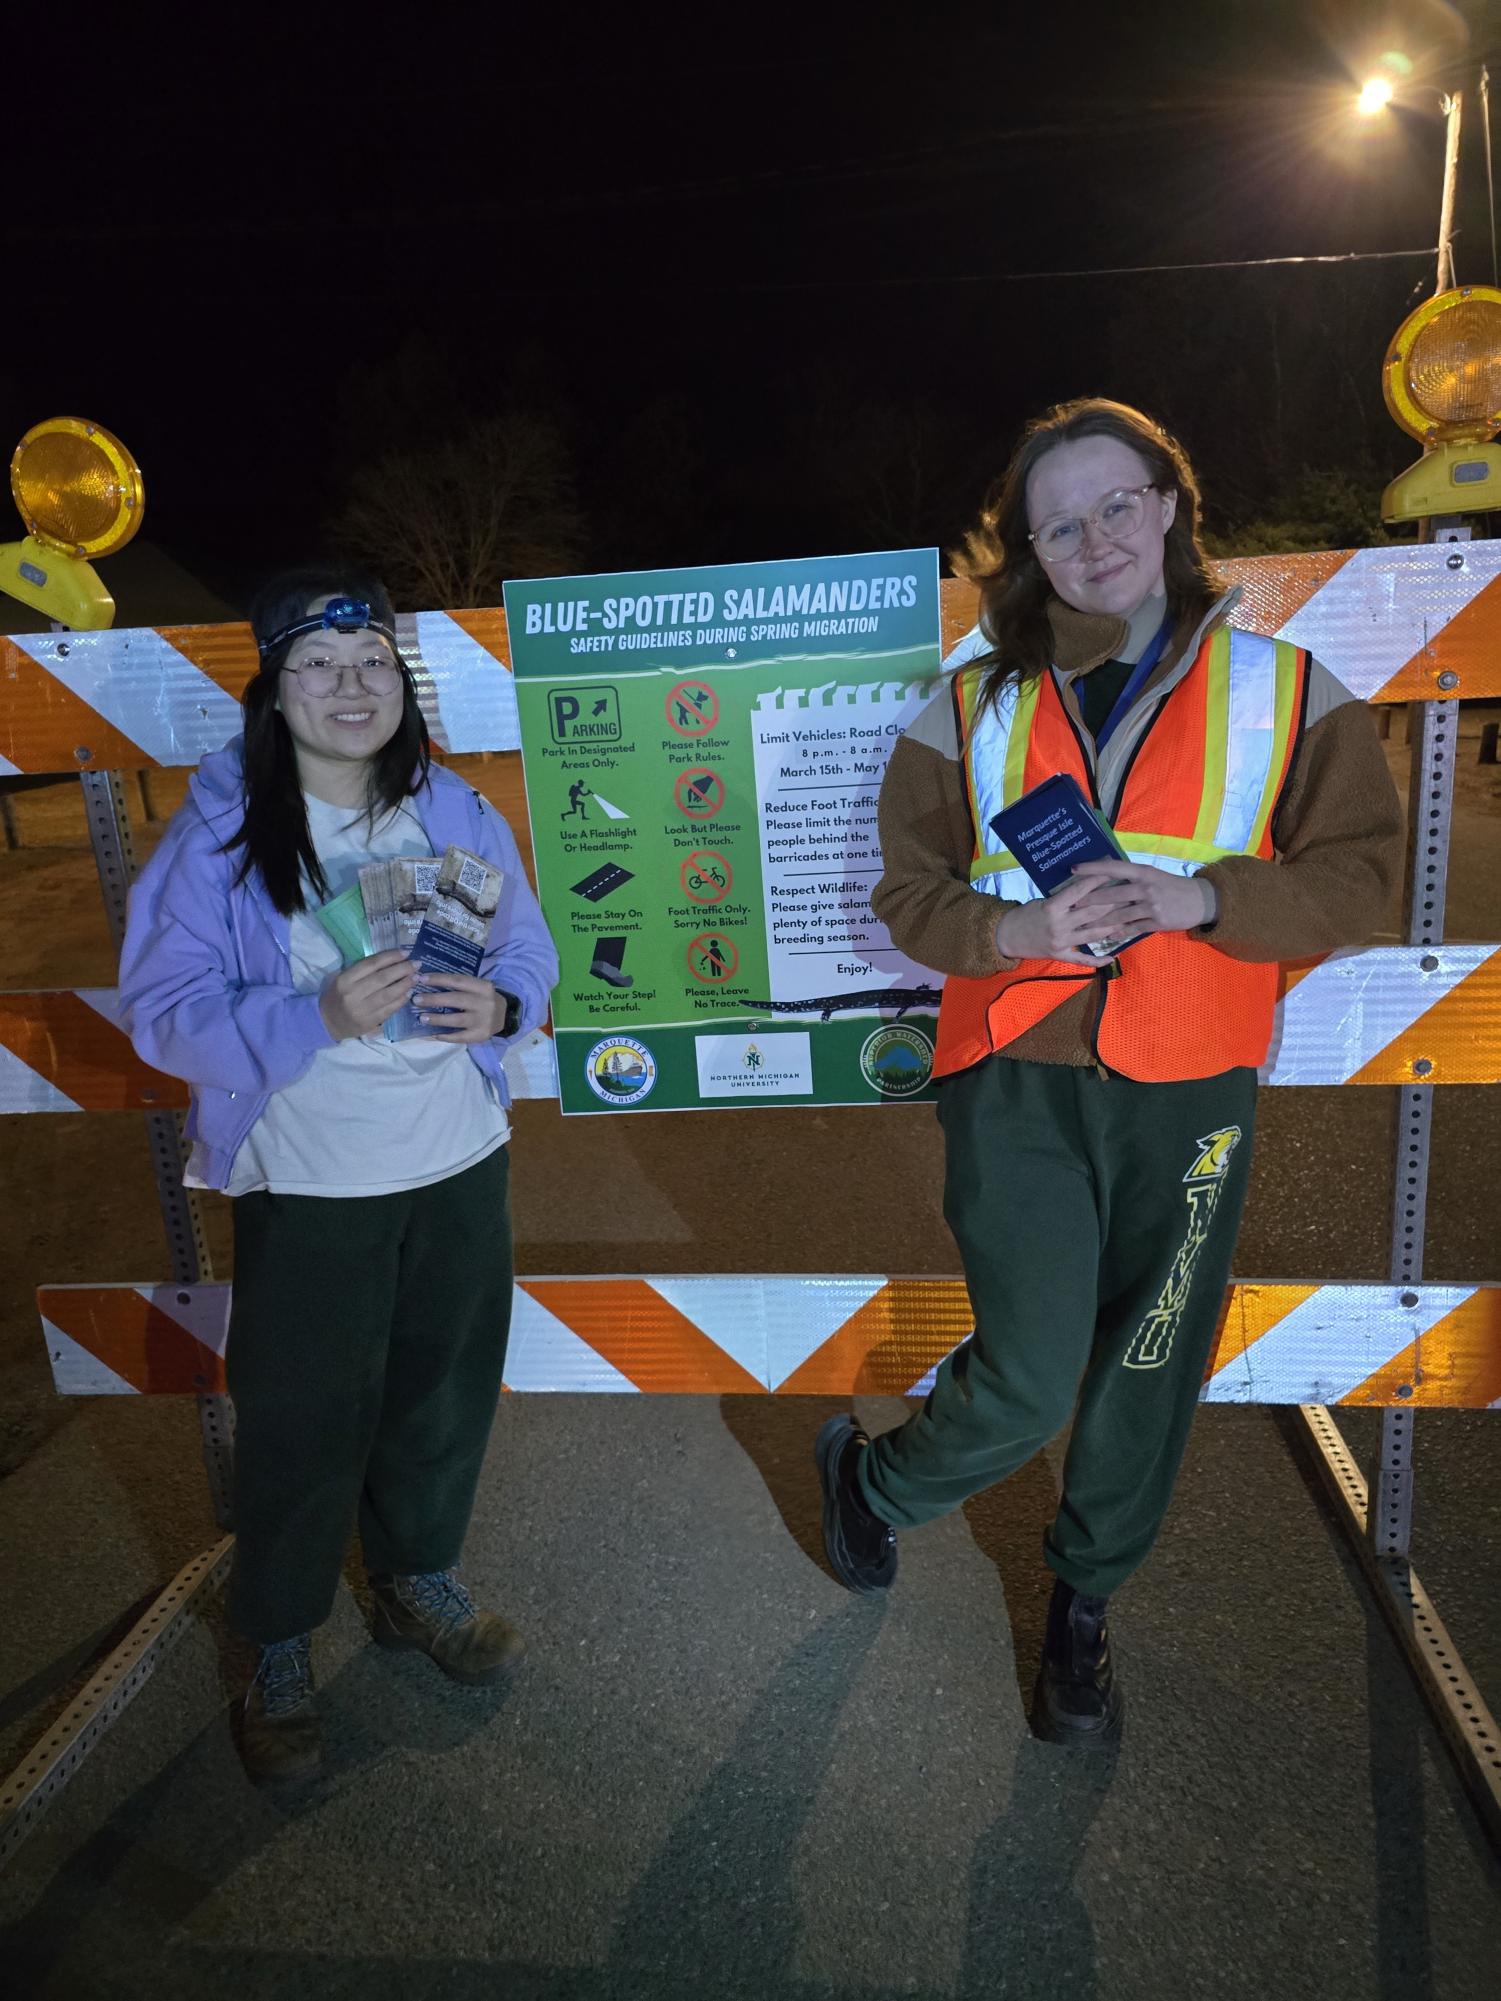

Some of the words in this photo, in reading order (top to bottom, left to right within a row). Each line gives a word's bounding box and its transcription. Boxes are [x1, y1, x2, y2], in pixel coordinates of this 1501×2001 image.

[525, 591, 715, 634] BLUE-SPOTTED
[722, 575, 917, 621] SALAMANDERS
[570, 635, 615, 654] SAFETY
[618, 630, 692, 650] GUIDELINES
[696, 626, 747, 645] DURING
[750, 622, 799, 641] SPRING
[803, 616, 879, 637] MIGRATION
[760, 733, 790, 744] Limit
[792, 729, 846, 742] Vehicles:
[849, 725, 882, 739] Road
[885, 724, 907, 736] Clo
[541, 747, 566, 757] Park
[567, 747, 578, 755] In
[579, 741, 635, 756] Designated
[662, 741, 694, 750] Please
[696, 737, 730, 748] Follow
[668, 752, 693, 763] Park
[695, 752, 725, 762] Rules.
[802, 749, 808, 758] 8
[850, 746, 856, 754] 8
[560, 760, 590, 770] Areas
[592, 757, 619, 769] Only.
[780, 765, 816, 778] March
[820, 764, 843, 775] 15th
[854, 762, 880, 775] May
[765, 801, 808, 813] Reduce
[810, 799, 838, 811] Foot
[664, 824, 689, 835] Look
[690, 824, 708, 833] But
[709, 822, 742, 833] Please
[766, 819, 803, 830] Please
[805, 817, 831, 828] limit
[834, 816, 852, 826] the
[855, 816, 879, 825] num
[1017, 807, 1067, 843] Marquette's
[560, 831, 578, 840] Use
[580, 829, 588, 839] A
[590, 827, 637, 839] Flashlight
[767, 835, 806, 849] people
[808, 832, 848, 845] behind
[850, 832, 870, 842] the
[1025, 828, 1058, 852] Presque
[1058, 818, 1074, 831] Isle
[564, 843, 577, 853] Or
[579, 842, 633, 852] Headlamp.
[673, 837, 700, 847] Don't
[701, 835, 734, 846] Touch.
[1031, 824, 1083, 863] Blue-Spotted
[768, 850, 830, 863] barricades
[832, 850, 844, 860] at
[846, 849, 868, 859] one
[871, 847, 883, 858] ti
[1038, 835, 1091, 872] Salamanders
[770, 885, 816, 898] Respect
[818, 881, 868, 894] Wildlife:
[668, 907, 690, 916] Foot
[691, 905, 723, 915] Traffic
[724, 904, 751, 915] Only.
[771, 902, 808, 913] Please
[810, 901, 835, 913] give
[837, 898, 872, 909] salam
[571, 911, 602, 921] Please
[604, 910, 626, 920] Stay
[628, 909, 643, 918] On
[571, 924, 589, 933] The
[591, 922, 642, 932] Pavement.
[674, 919, 701, 929] Sorry
[703, 918, 717, 927] No
[719, 916, 748, 926] Bikes!
[773, 918, 808, 931] plenty
[811, 916, 823, 927] of
[825, 917, 857, 928] space
[859, 914, 882, 924] dur
[773, 933, 824, 945] breeding
[827, 933, 870, 942] season.
[837, 961, 873, 976] Enjoy!
[573, 992, 604, 1002] Watch
[606, 991, 629, 1000] Your
[632, 989, 656, 1001] Step!
[685, 987, 719, 997] Please,
[721, 987, 750, 996] Leave
[588, 1005, 601, 1013] Be
[602, 1003, 641, 1013] Careful.
[694, 1000, 708, 1008] No
[710, 999, 740, 1008] Trace.
[590, 1038, 649, 1058] MARQUETTE
[600, 1088, 646, 1103] MICHIGAN
